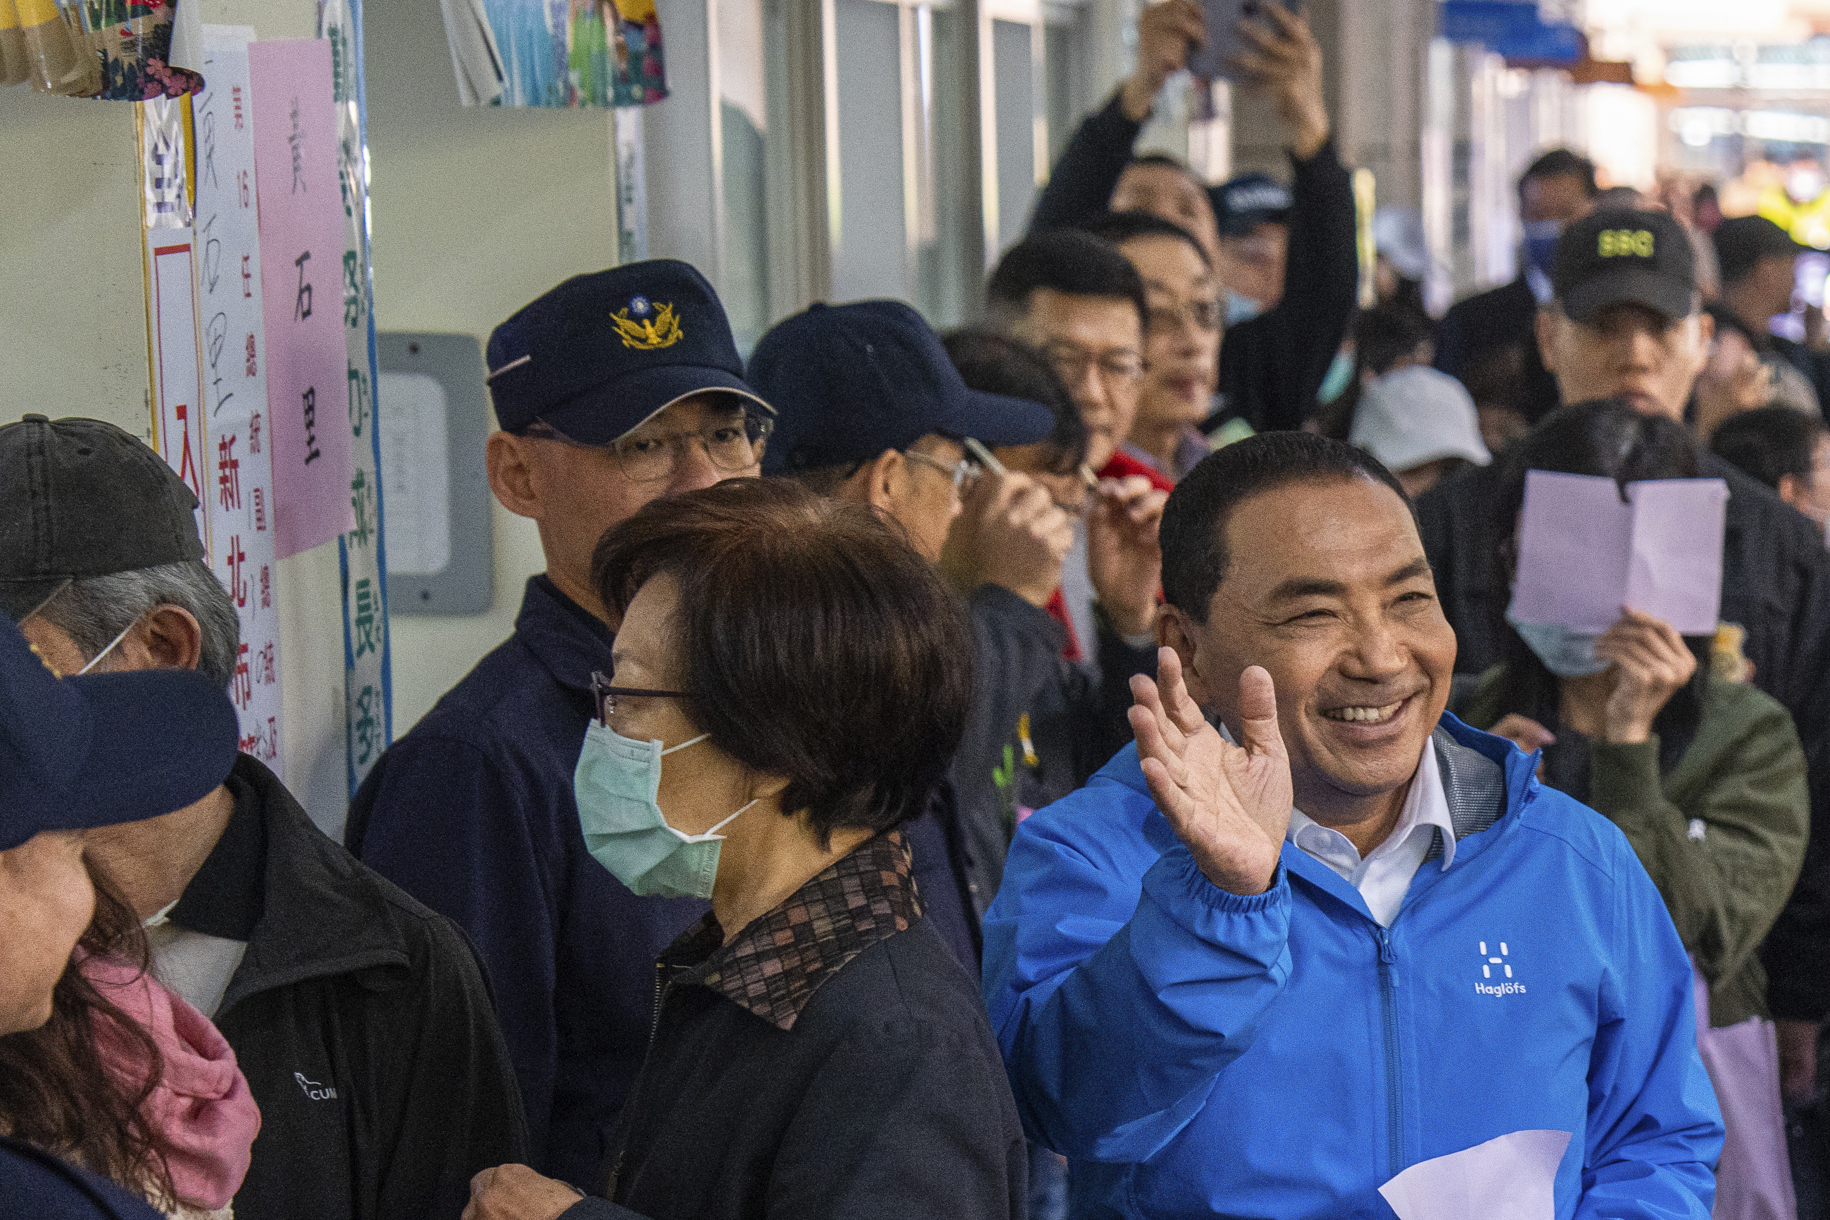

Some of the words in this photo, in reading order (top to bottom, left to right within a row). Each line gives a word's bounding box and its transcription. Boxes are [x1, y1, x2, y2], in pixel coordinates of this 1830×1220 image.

[218, 434, 256, 754] 新北市
[1474, 981, 1527, 998] Haglöfs
